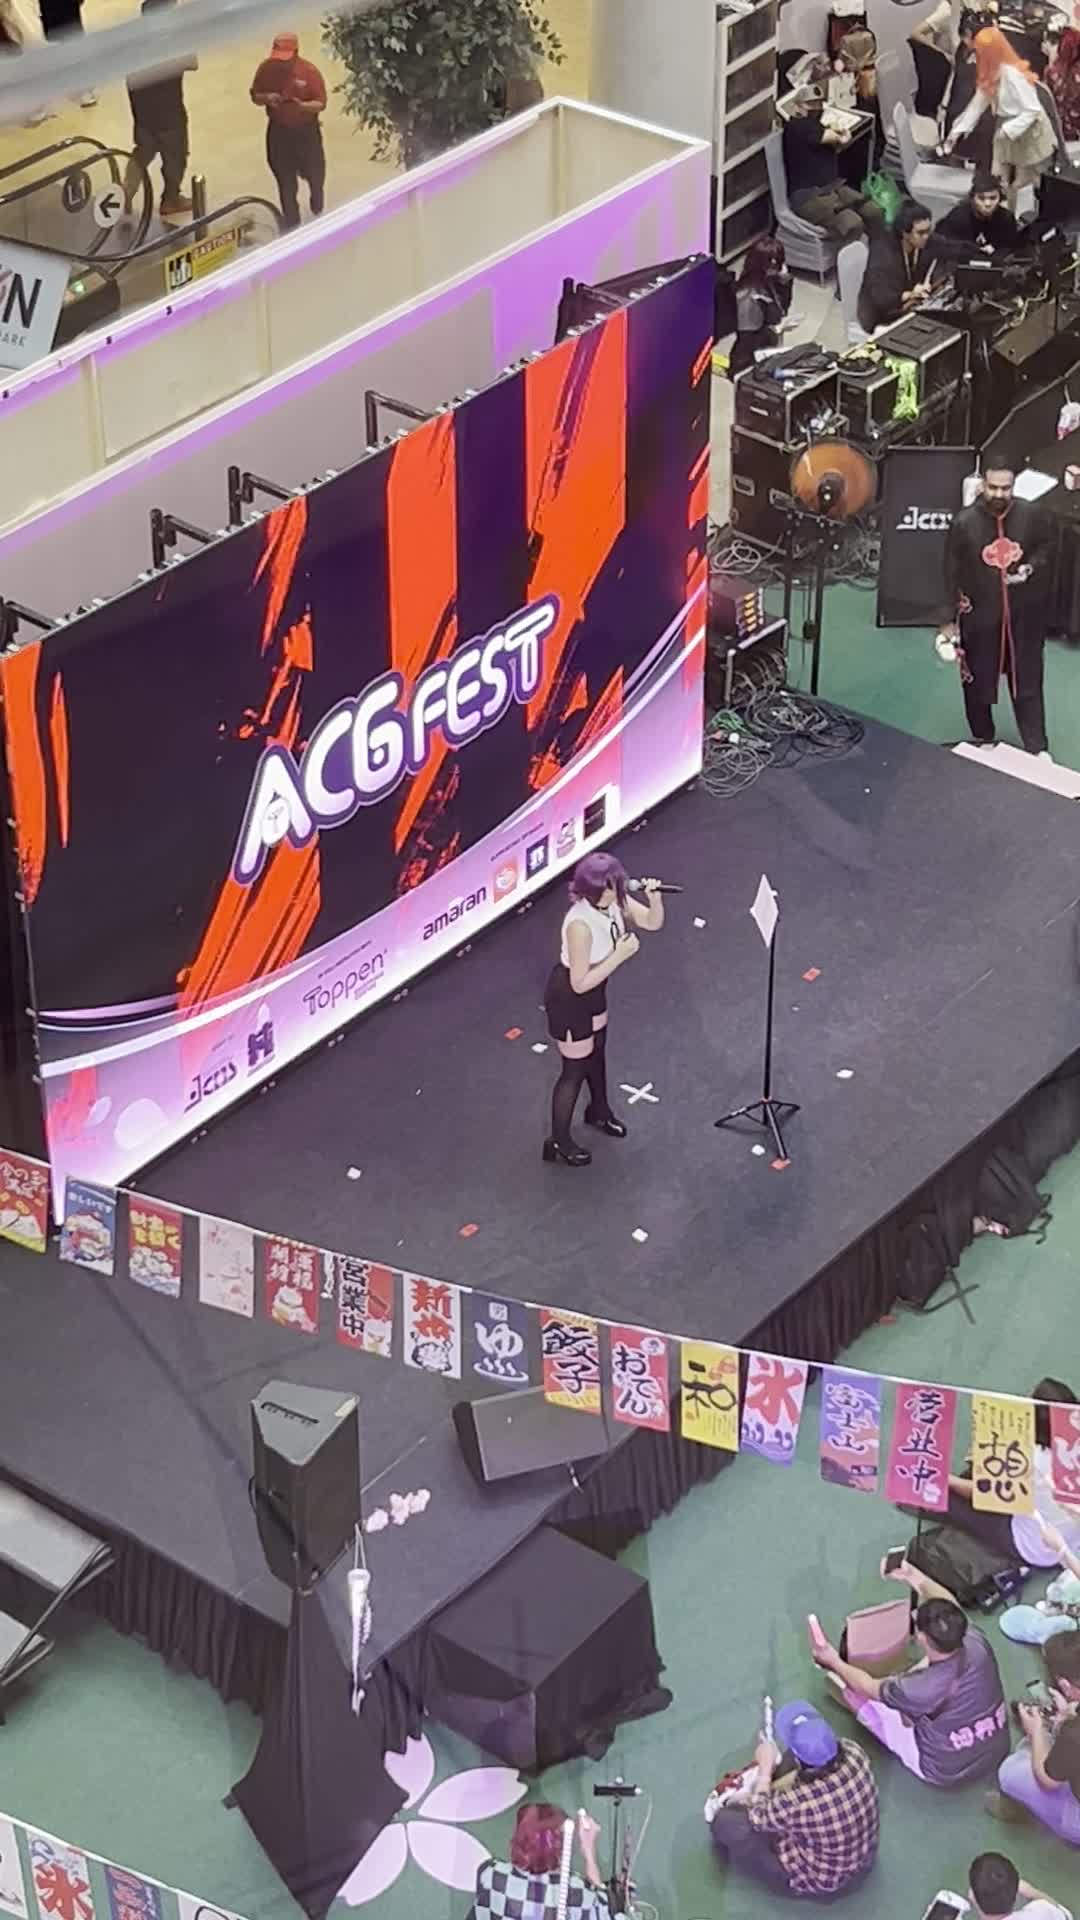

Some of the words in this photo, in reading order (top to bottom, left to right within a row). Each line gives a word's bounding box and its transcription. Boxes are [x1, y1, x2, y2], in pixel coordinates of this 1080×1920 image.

[0, 271, 42, 328] N
[0, 331, 26, 347] ARK
[237, 676, 404, 880] ACG
[410, 600, 558, 768] FEST
[422, 885, 487, 940] amaran
[303, 949, 385, 1016] Toppen
[474, 1321, 524, 1360] ゆ
